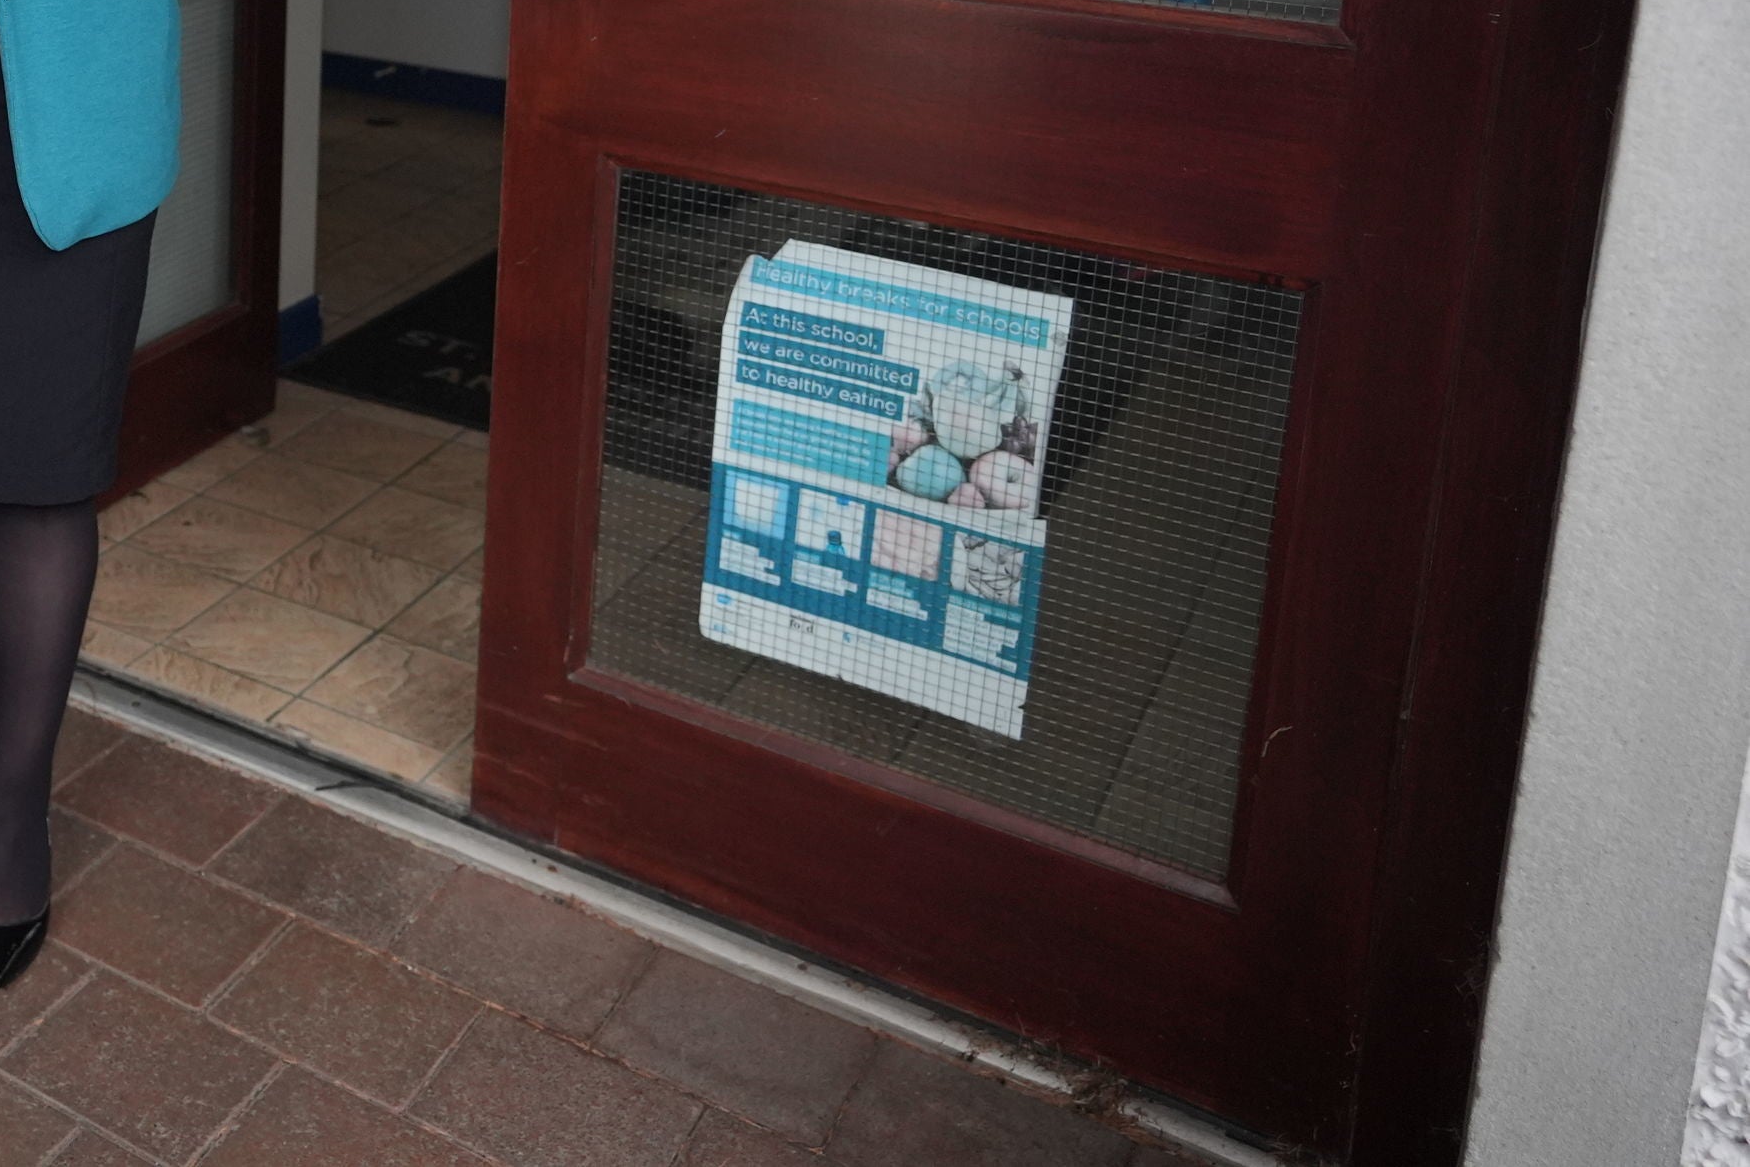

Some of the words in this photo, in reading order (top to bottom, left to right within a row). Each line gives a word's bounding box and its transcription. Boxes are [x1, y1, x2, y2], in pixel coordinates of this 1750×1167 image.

[756, 260, 832, 295] Healthy
[838, 276, 911, 308] breaks
[956, 308, 1041, 341] schools
[746, 309, 767, 325] At
[773, 312, 806, 333] this
[811, 322, 878, 350] school,
[744, 340, 770, 353] we
[775, 345, 805, 361] are
[809, 352, 914, 387] committed
[741, 365, 759, 381] to
[766, 369, 834, 400] healthy
[839, 389, 898, 418] eating
[789, 619, 814, 634] fod
